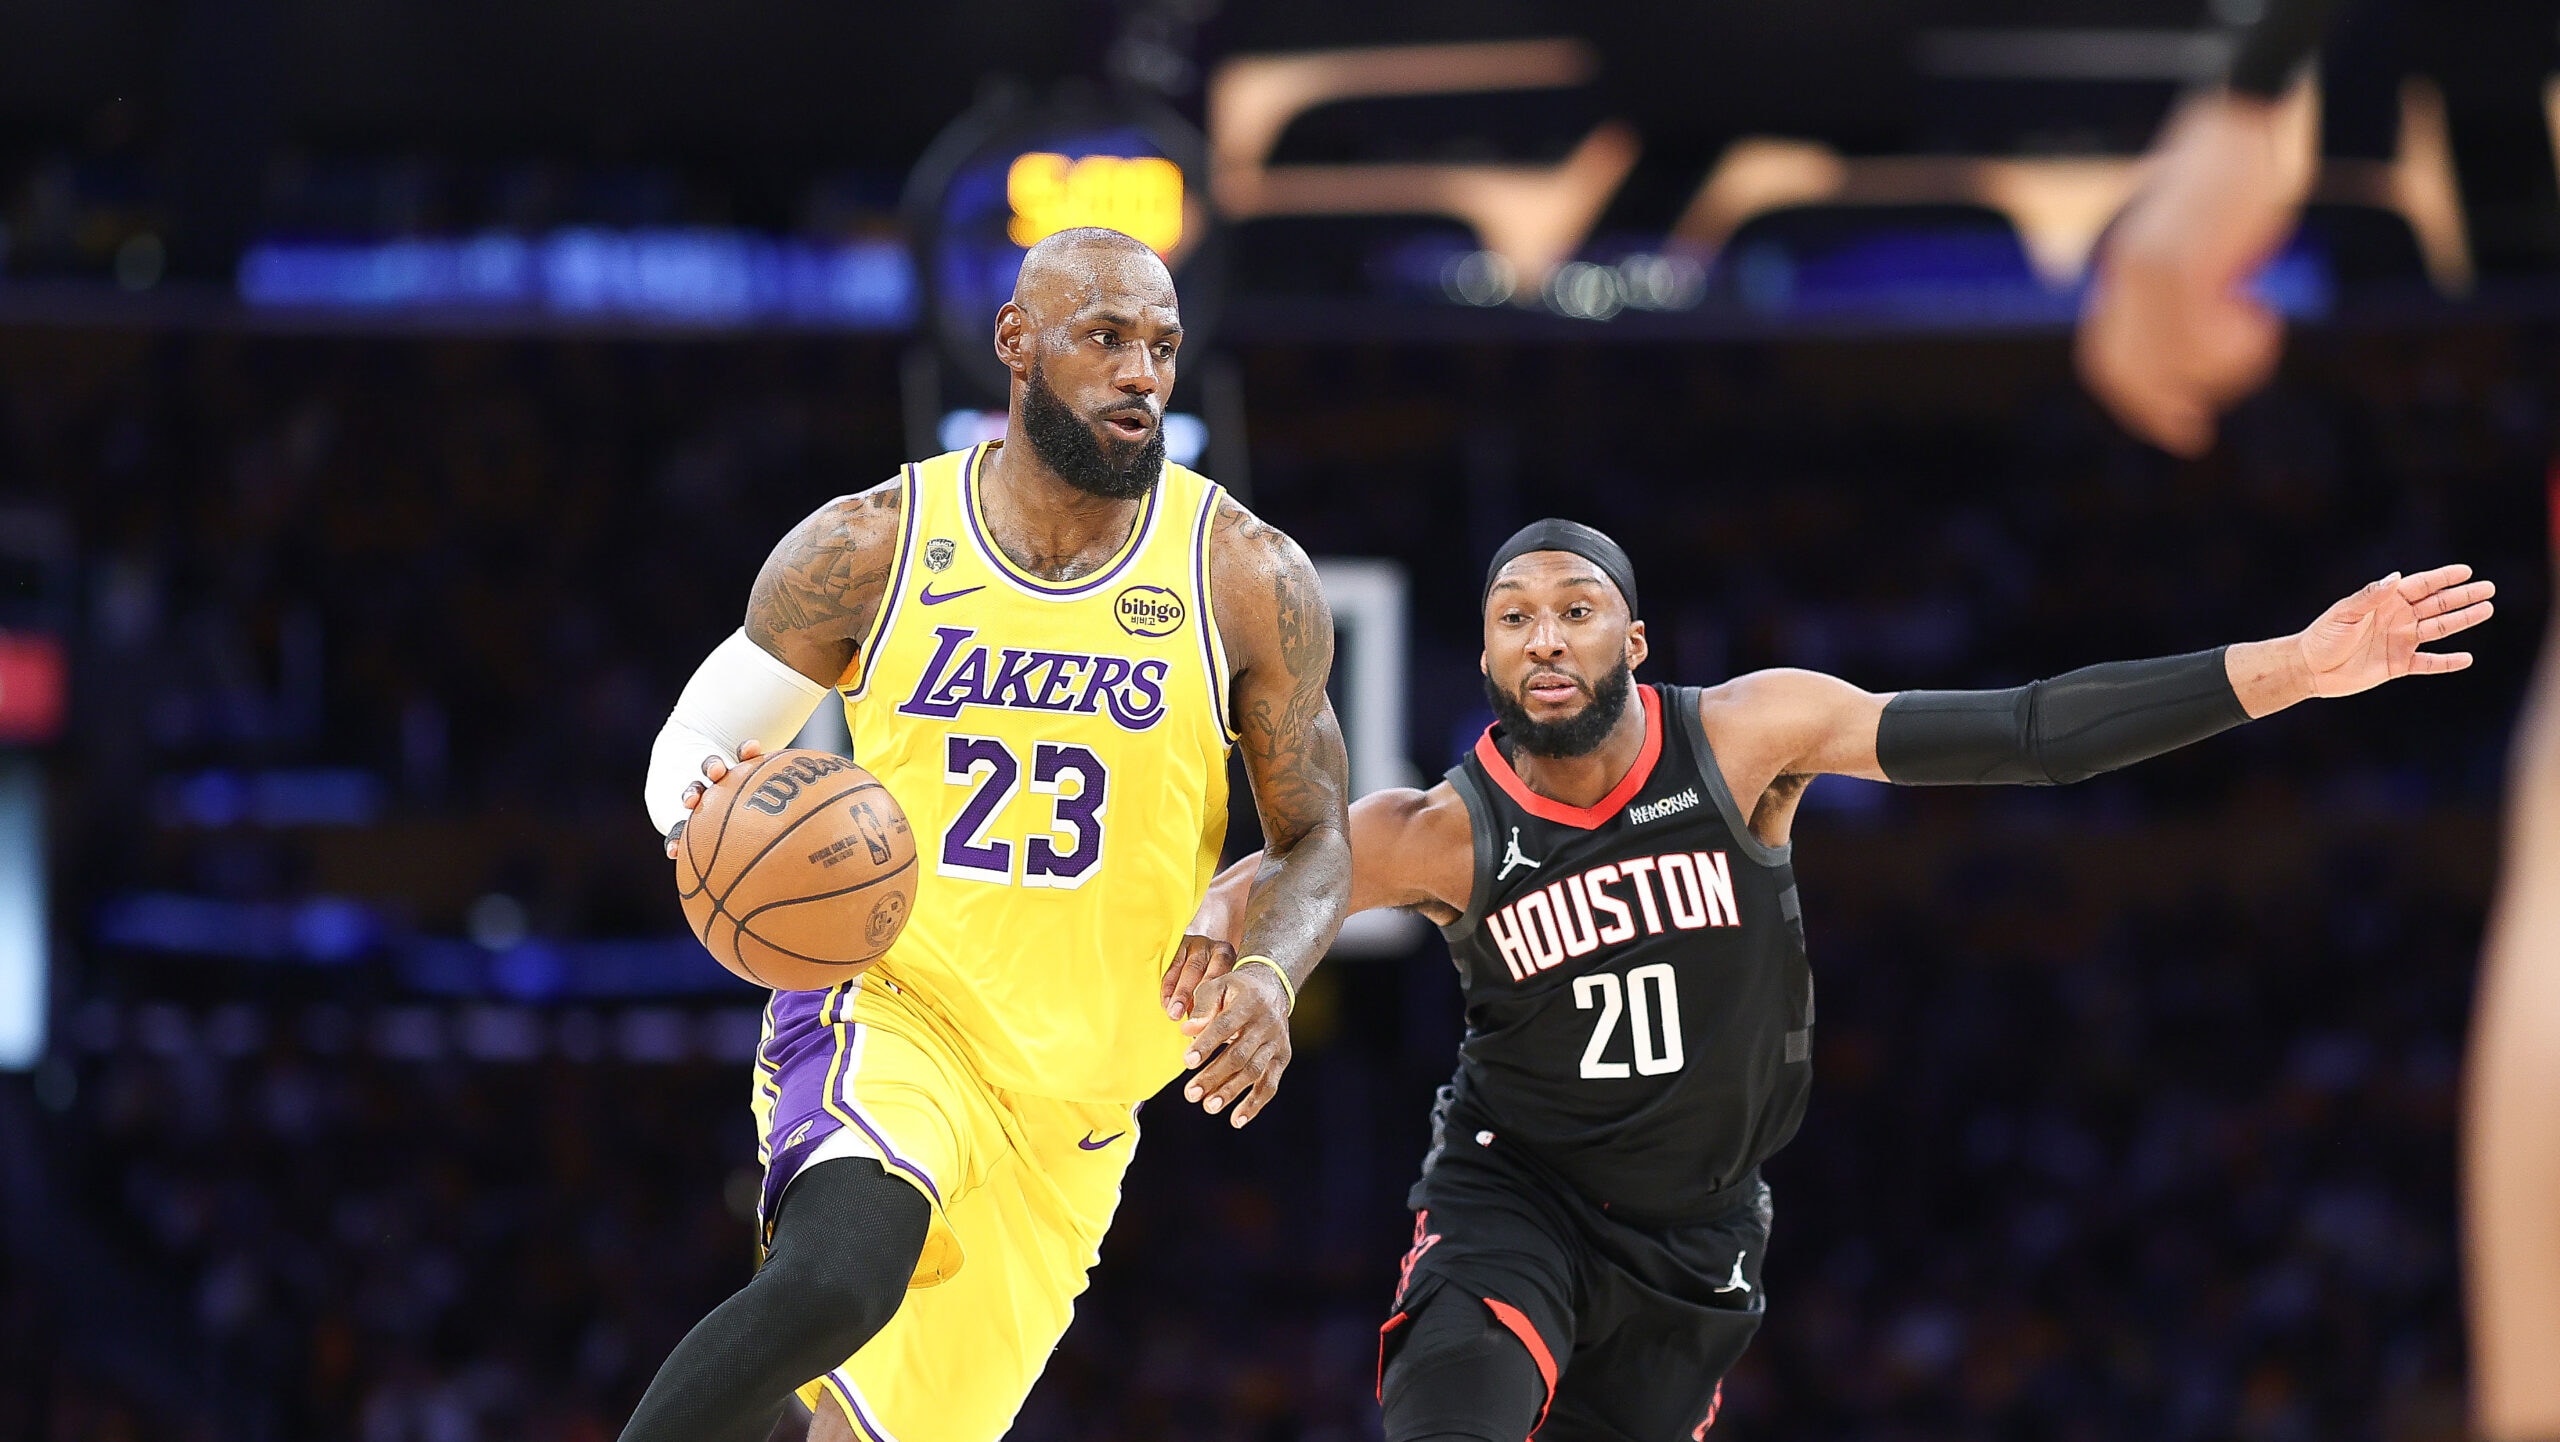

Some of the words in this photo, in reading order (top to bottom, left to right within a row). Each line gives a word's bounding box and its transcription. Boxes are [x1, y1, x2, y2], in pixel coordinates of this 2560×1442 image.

[1121, 598, 1181, 623] bibigo
[1130, 616, 1156, 626] 비비고
[896, 624, 1172, 733] LAKERS
[937, 733, 1111, 890] 23
[1629, 787, 1698, 817] MEMORIAL
[1631, 793, 1699, 825] HERMANN
[1486, 852, 1740, 982] HOUSTON
[1572, 963, 1685, 1079] 20
